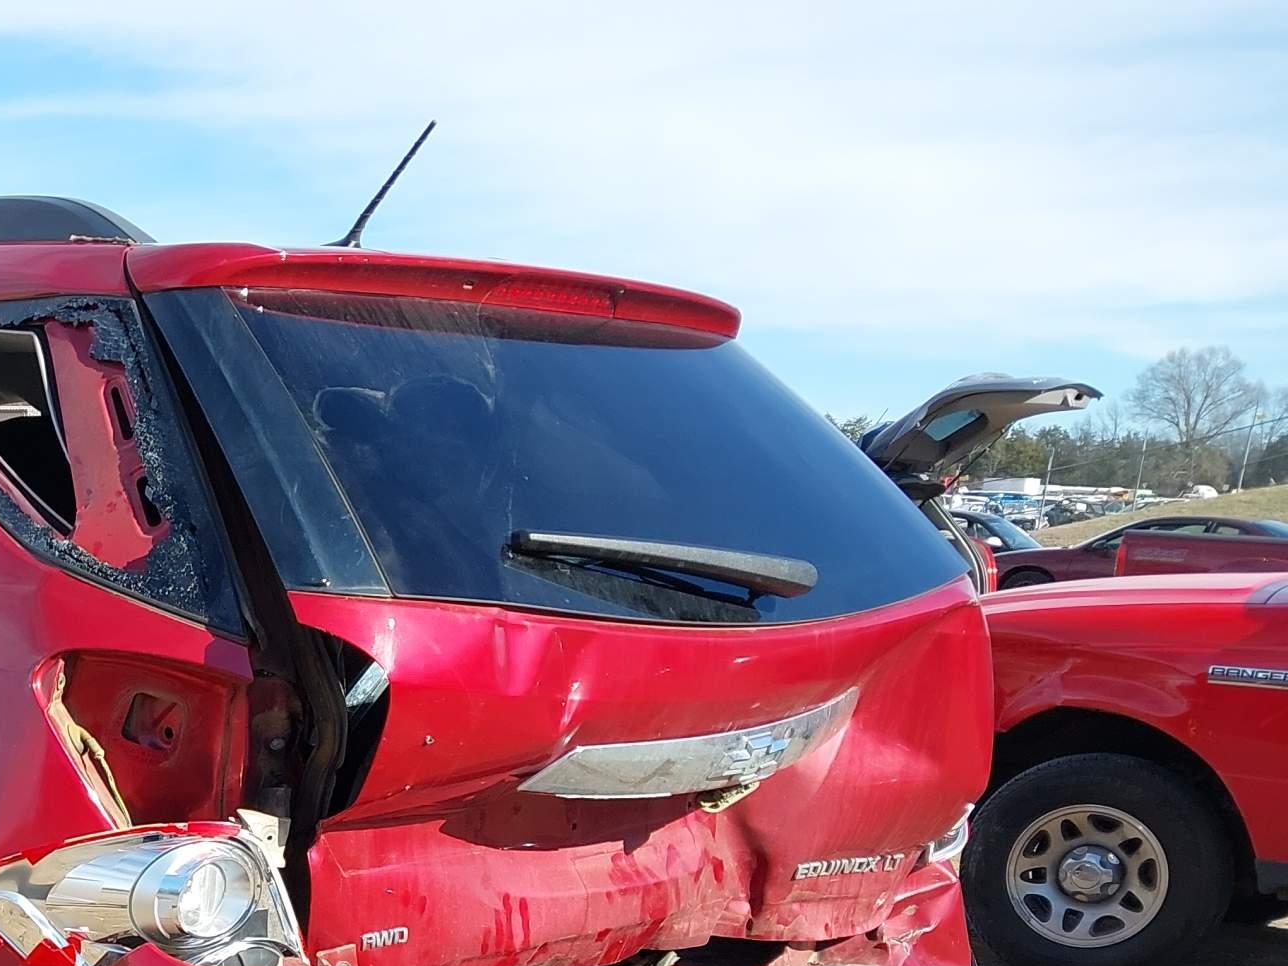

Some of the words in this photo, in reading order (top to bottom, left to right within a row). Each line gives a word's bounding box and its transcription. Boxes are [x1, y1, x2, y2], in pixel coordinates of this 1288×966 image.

[792, 856, 881, 880] EQUINOX
[883, 853, 905, 873] LT
[360, 926, 409, 952] AWD
